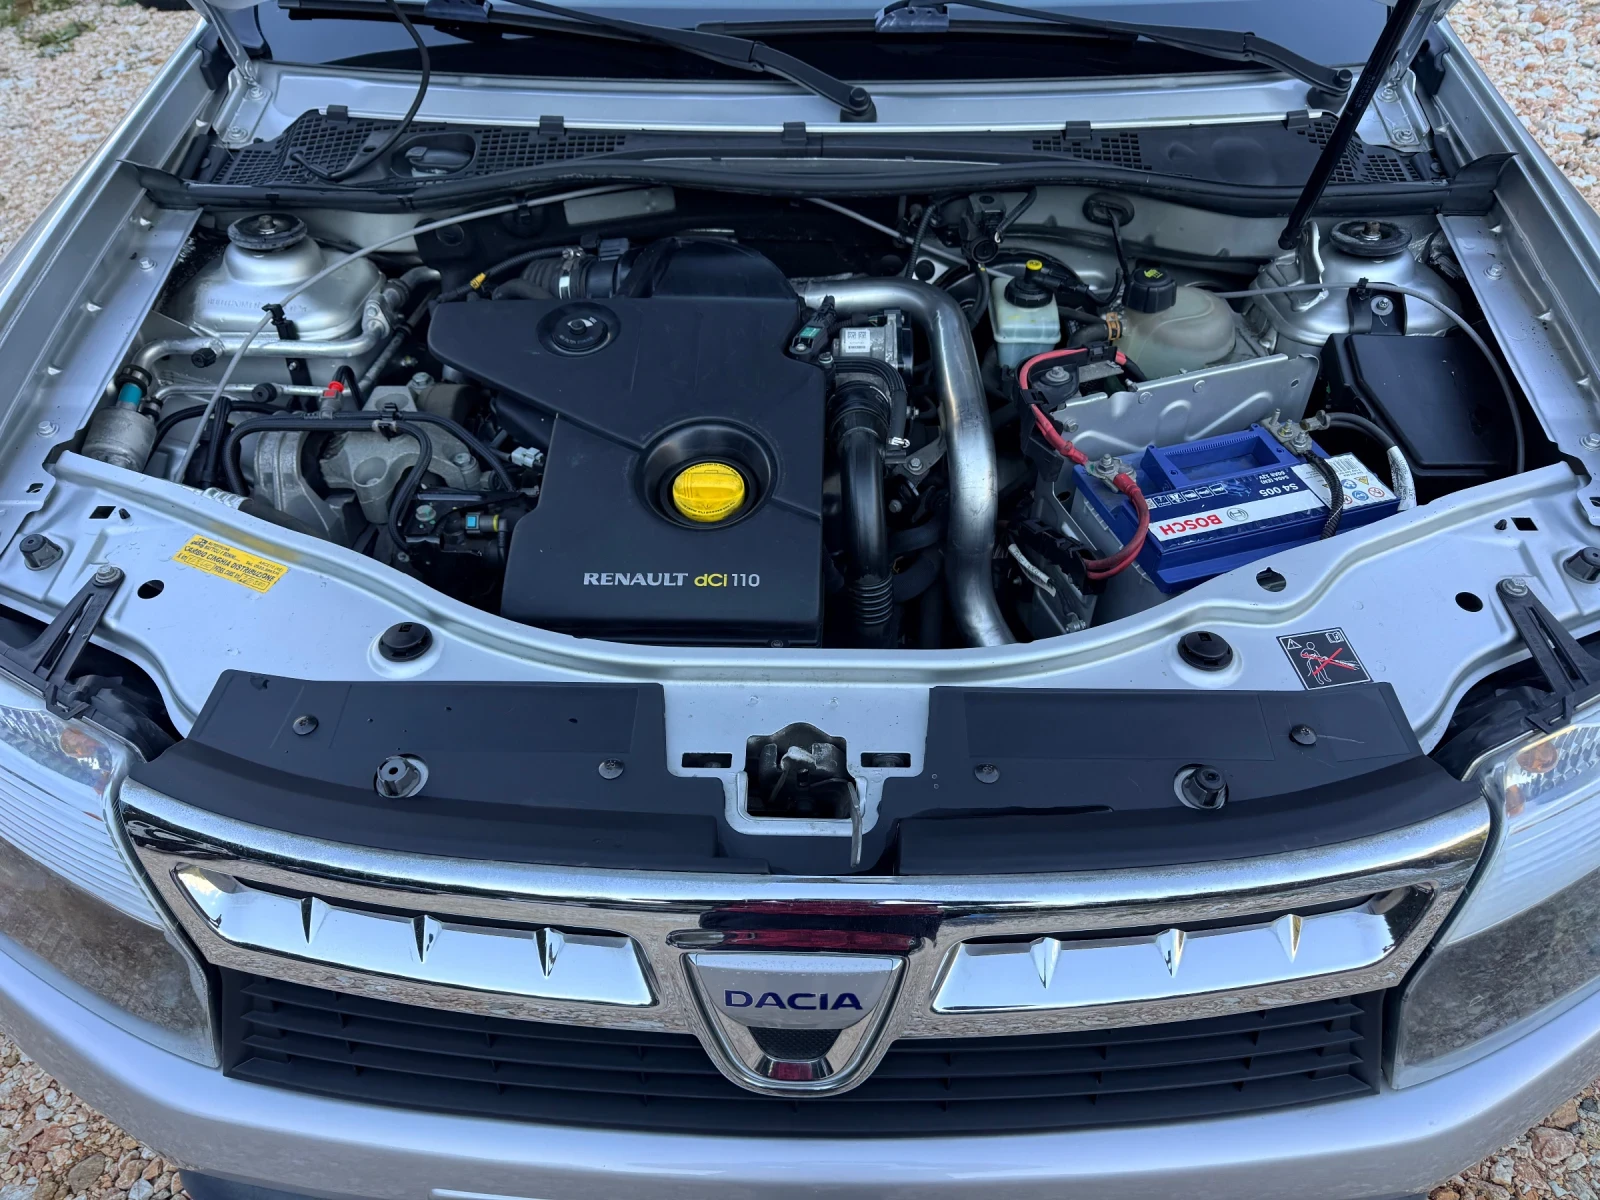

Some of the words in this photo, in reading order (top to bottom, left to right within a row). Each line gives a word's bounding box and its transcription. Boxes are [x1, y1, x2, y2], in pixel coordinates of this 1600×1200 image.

[1259, 487, 1281, 497] 005
[1282, 483, 1298, 492] S4
[1159, 514, 1222, 535] BOSCH
[184, 545, 208, 558] CAMBIO
[206, 553, 230, 567] CINGHIA
[231, 562, 276, 582] DISTRIBUZIONE
[583, 572, 688, 586] RENAULT
[694, 573, 728, 587] dCi
[731, 573, 760, 587] 110
[724, 989, 863, 1010] DACIA
